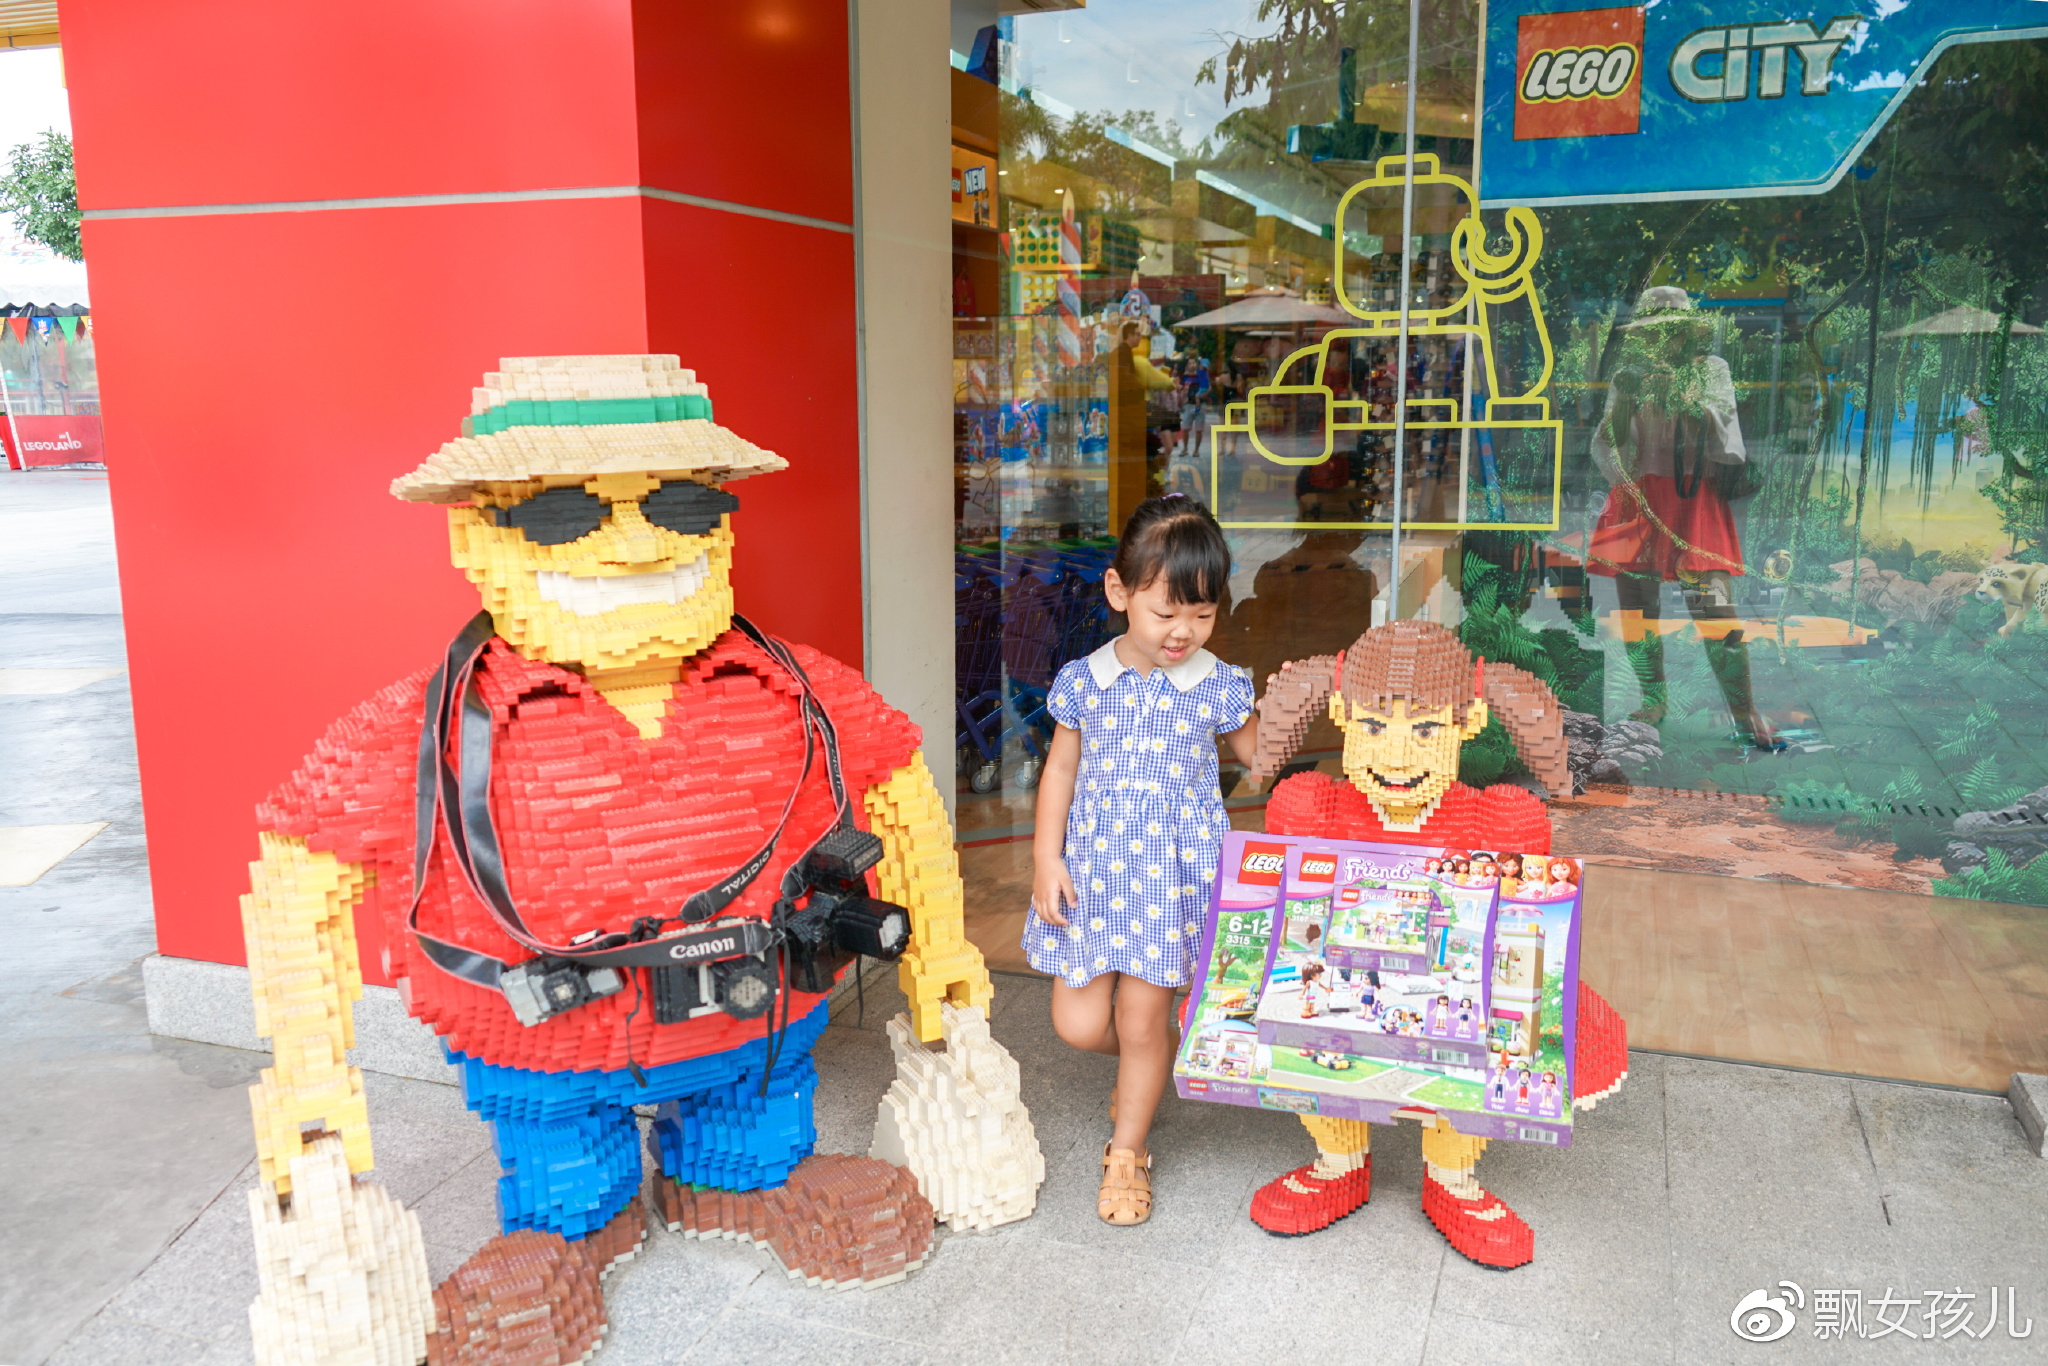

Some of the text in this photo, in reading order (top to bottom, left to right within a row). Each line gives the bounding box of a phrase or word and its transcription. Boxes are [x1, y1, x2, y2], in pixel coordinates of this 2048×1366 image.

[1521, 15, 1863, 103] LEGO CITY
[965, 167, 987, 194] NEW
[23, 432, 82, 451] LEGOLAND
[721, 850, 770, 895] DIGITAL
[1301, 860, 1335, 875] LEGO
[1293, 902, 1325, 917] 6-12
[1228, 915, 1272, 936] 6-12
[669, 937, 735, 959] Canon
[1225, 934, 1251, 945] 3315
